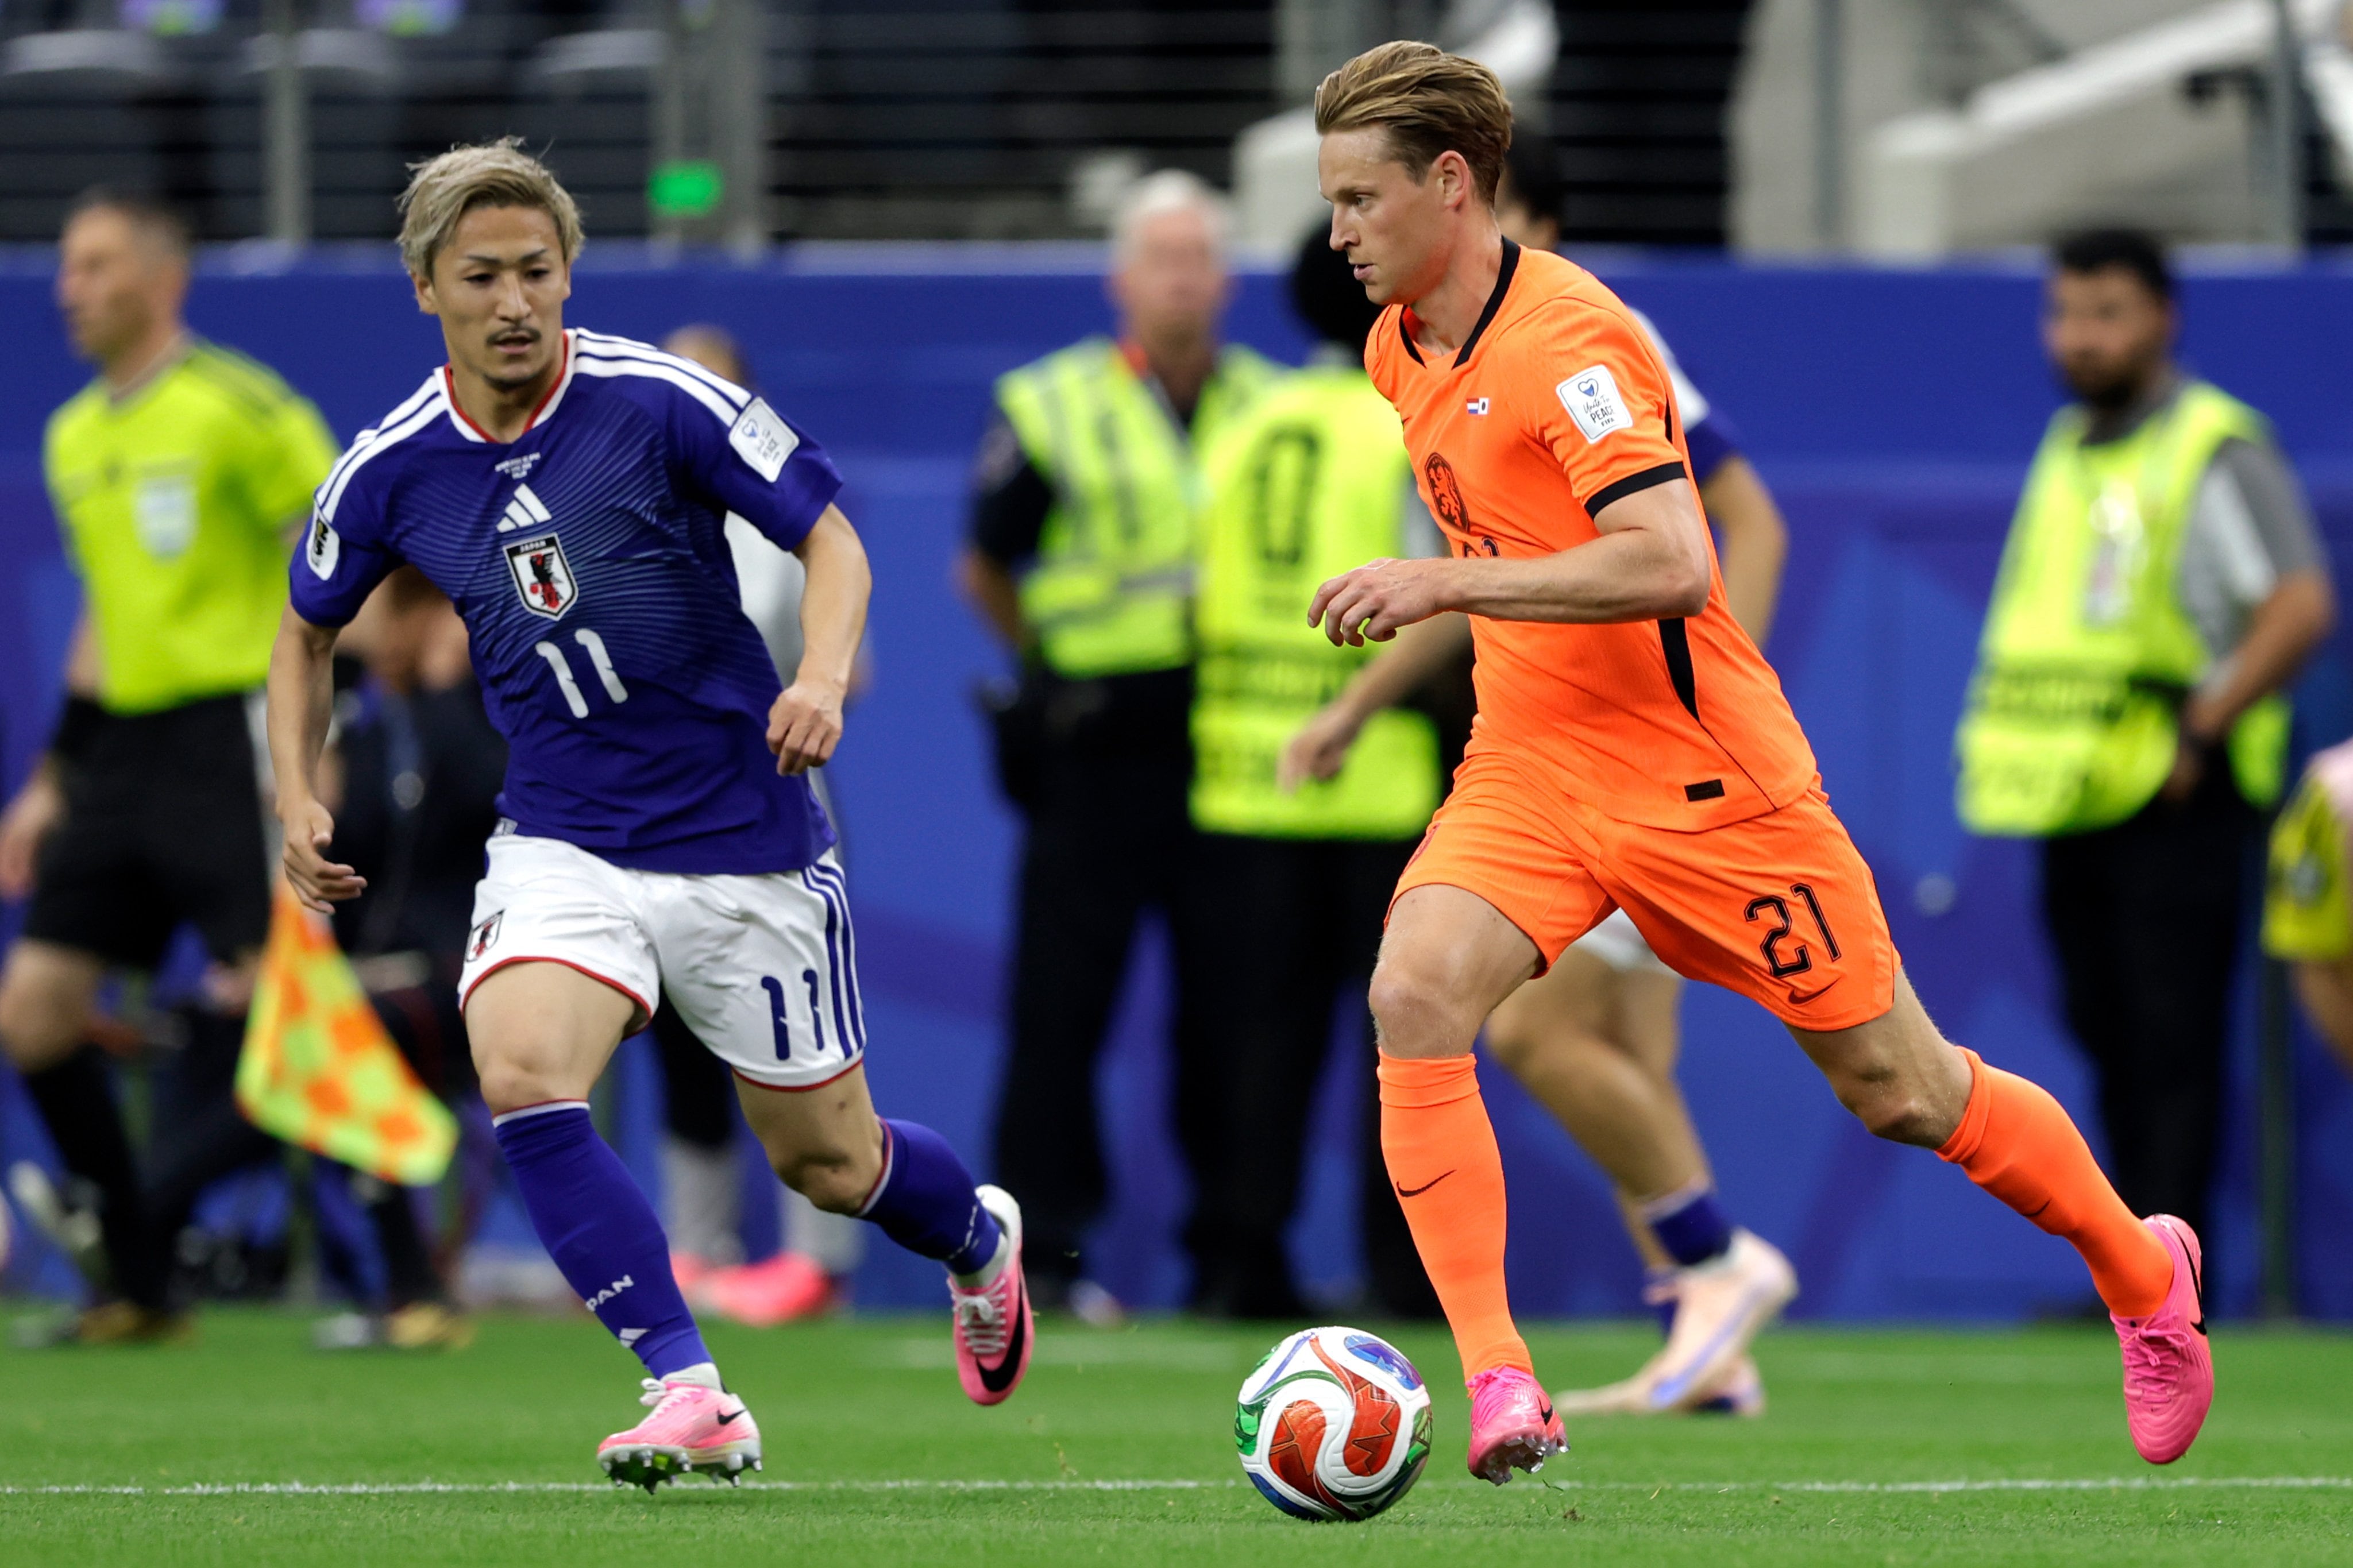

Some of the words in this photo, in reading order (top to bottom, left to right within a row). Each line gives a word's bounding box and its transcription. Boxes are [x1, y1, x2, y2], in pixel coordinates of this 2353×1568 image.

[535, 628, 628, 719] 11
[1743, 883, 1842, 979] 21
[761, 969, 824, 1061] 11
[586, 1274, 634, 1312] PAN
